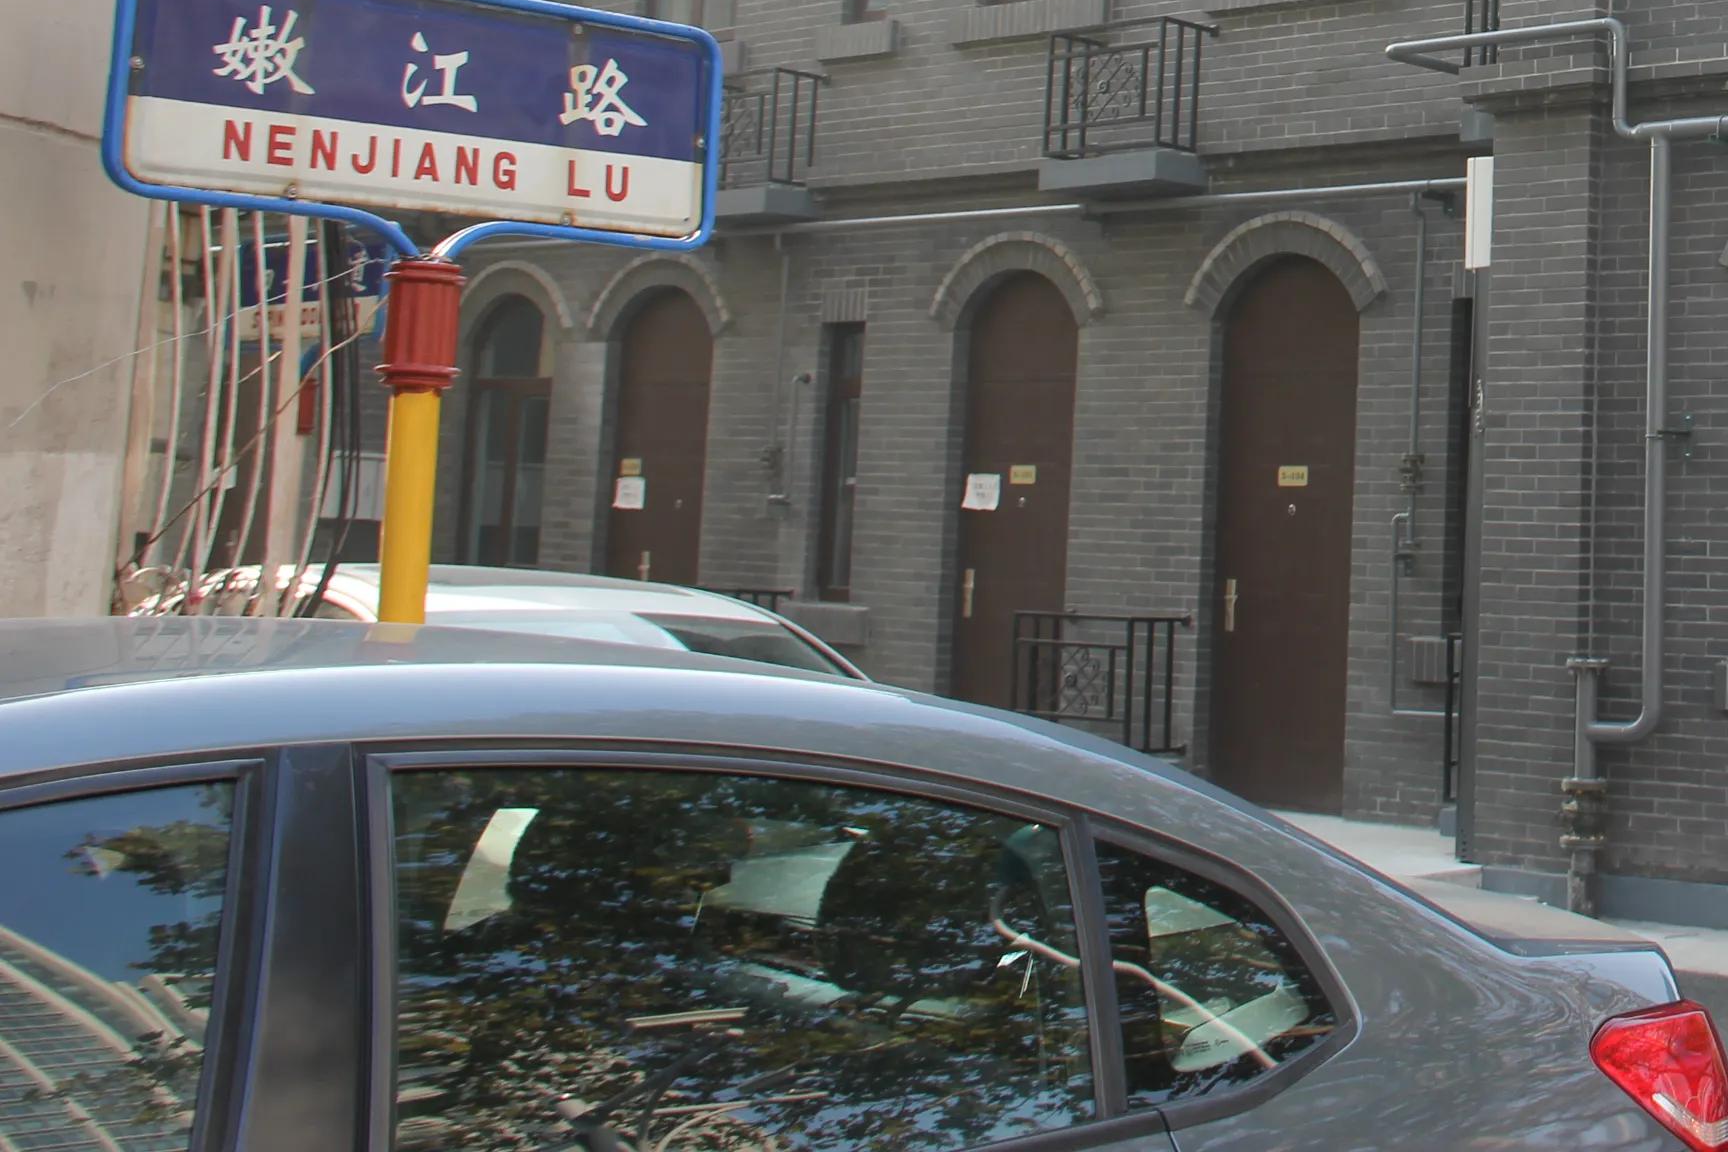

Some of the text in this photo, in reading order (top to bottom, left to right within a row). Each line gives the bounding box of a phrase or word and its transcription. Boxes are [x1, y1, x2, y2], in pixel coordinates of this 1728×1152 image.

[213, 5, 648, 137] 嫩江路
[223, 119, 630, 203] NENJIANG LU
